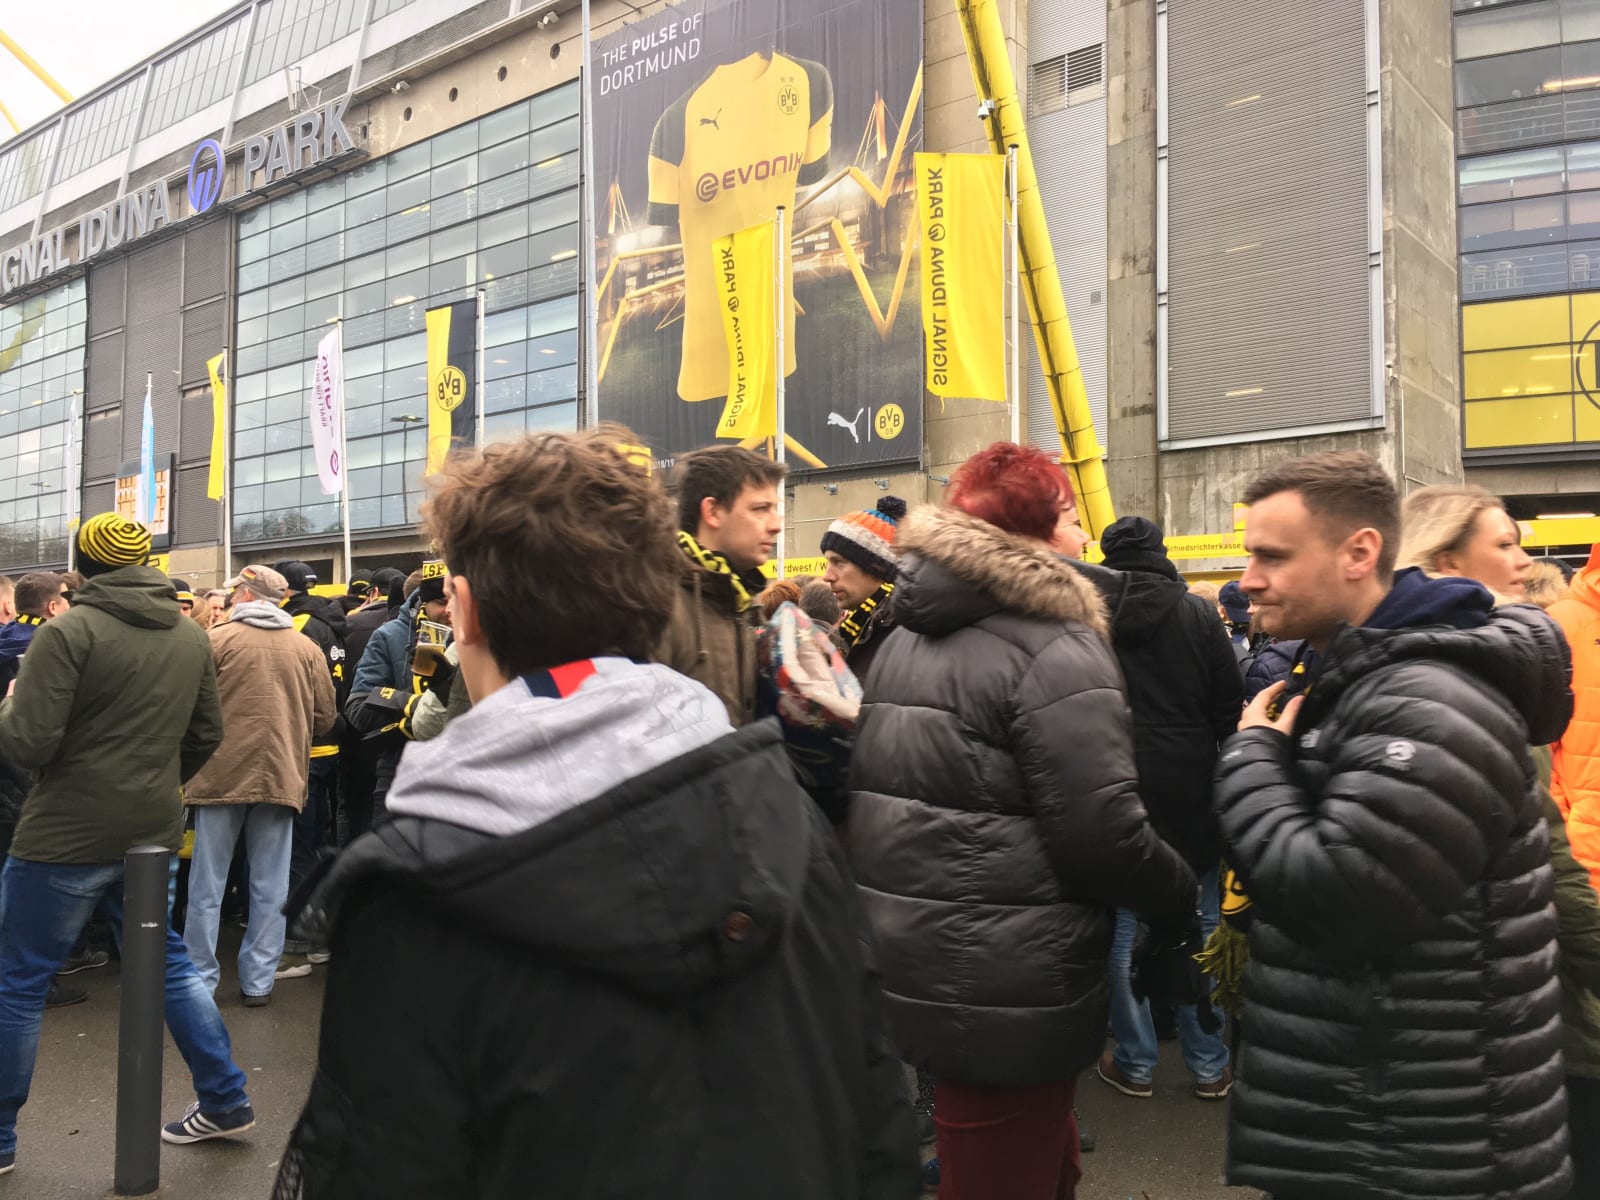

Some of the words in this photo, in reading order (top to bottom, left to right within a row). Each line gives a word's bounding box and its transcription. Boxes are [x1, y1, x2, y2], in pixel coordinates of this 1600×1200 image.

[602, 43, 627, 69] THE
[632, 22, 678, 56] PULSE
[682, 12, 702, 34] OF
[599, 37, 701, 96] DORTMUND
[781, 87, 798, 107] BVB
[0, 229, 71, 293] GNAL
[79, 179, 171, 262] IDUNA
[243, 92, 356, 191] PARK
[880, 408, 901, 429] BVB
[772, 563, 812, 573] Nrdwest
